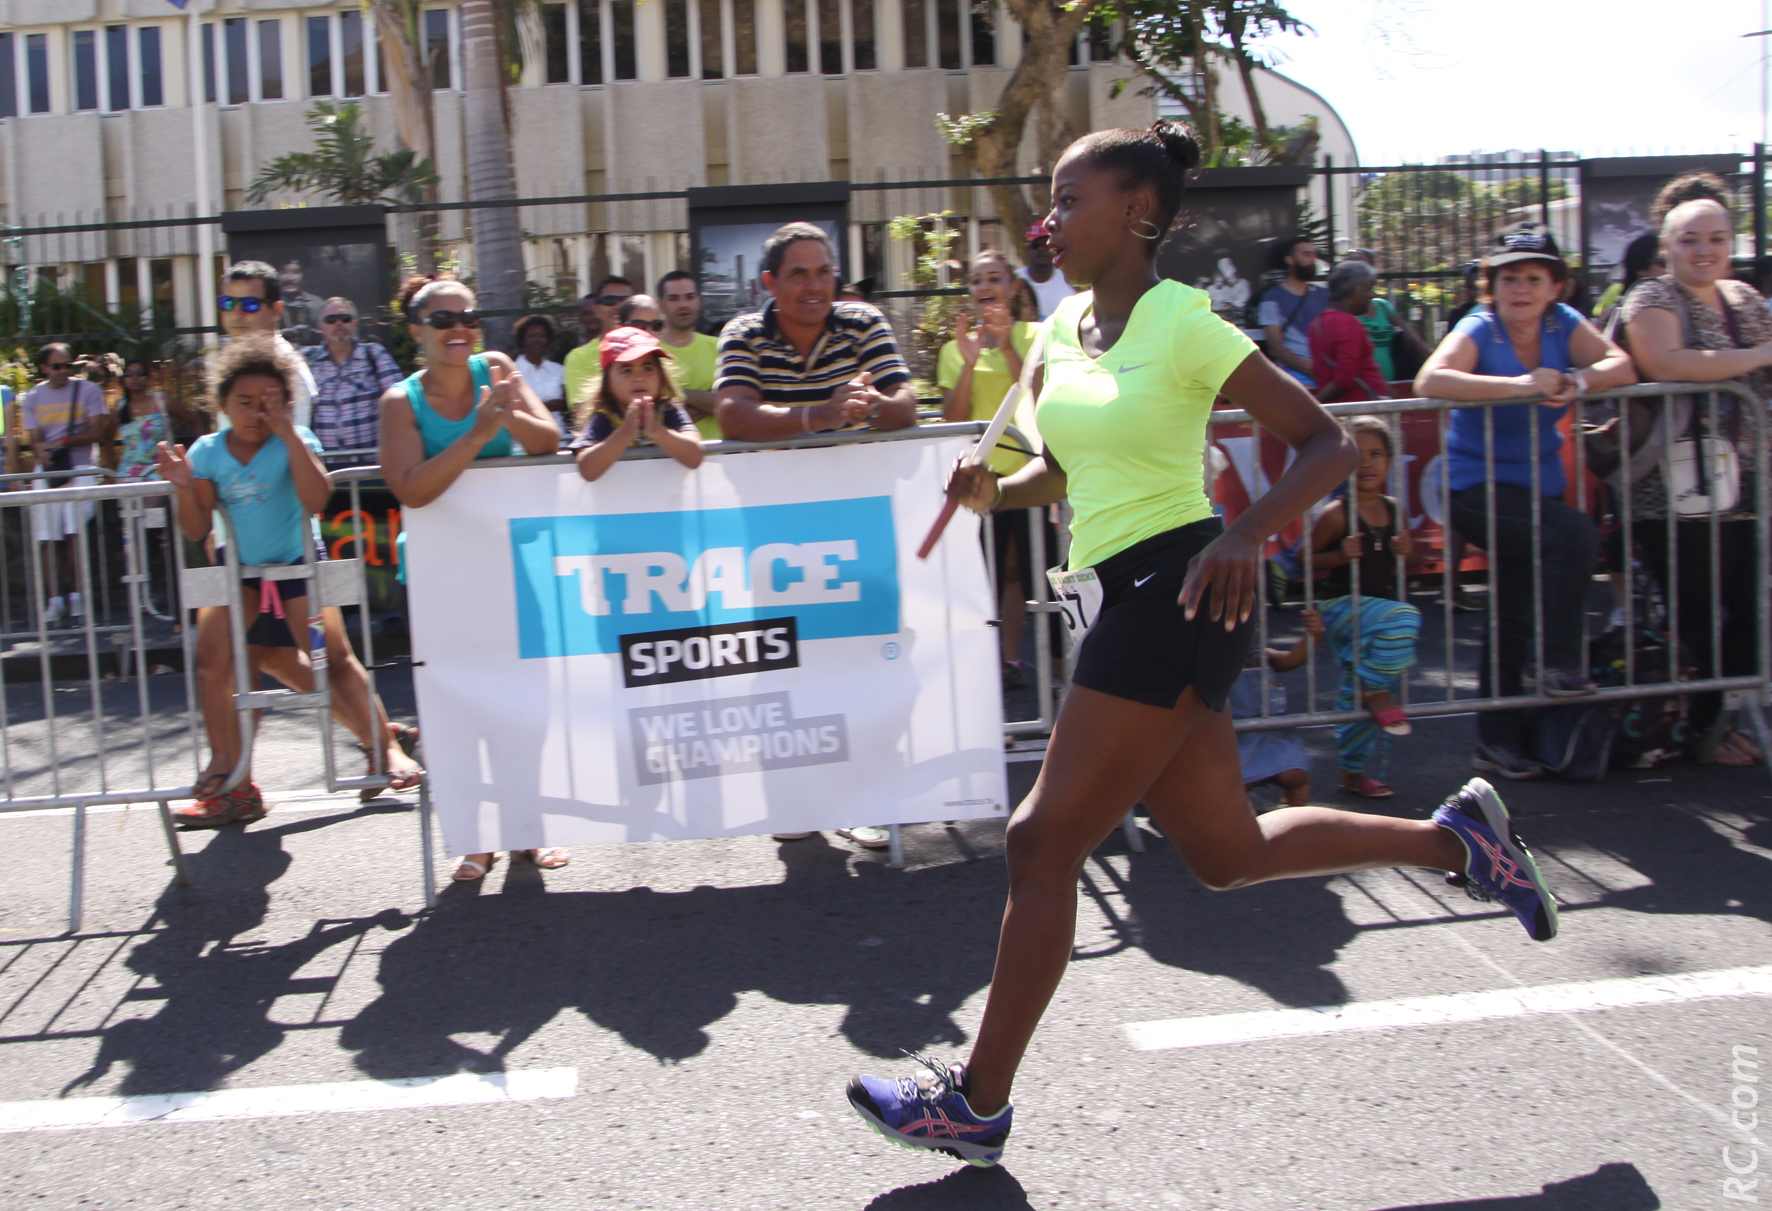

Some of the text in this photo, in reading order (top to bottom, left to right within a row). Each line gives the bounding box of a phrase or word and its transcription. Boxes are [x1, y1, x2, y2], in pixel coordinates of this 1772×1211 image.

[554, 539, 861, 616] TRACE
[629, 627, 791, 677] SPORTS
[639, 702, 787, 742] WE LOVE
[646, 725, 841, 775] CHAMPIONS
